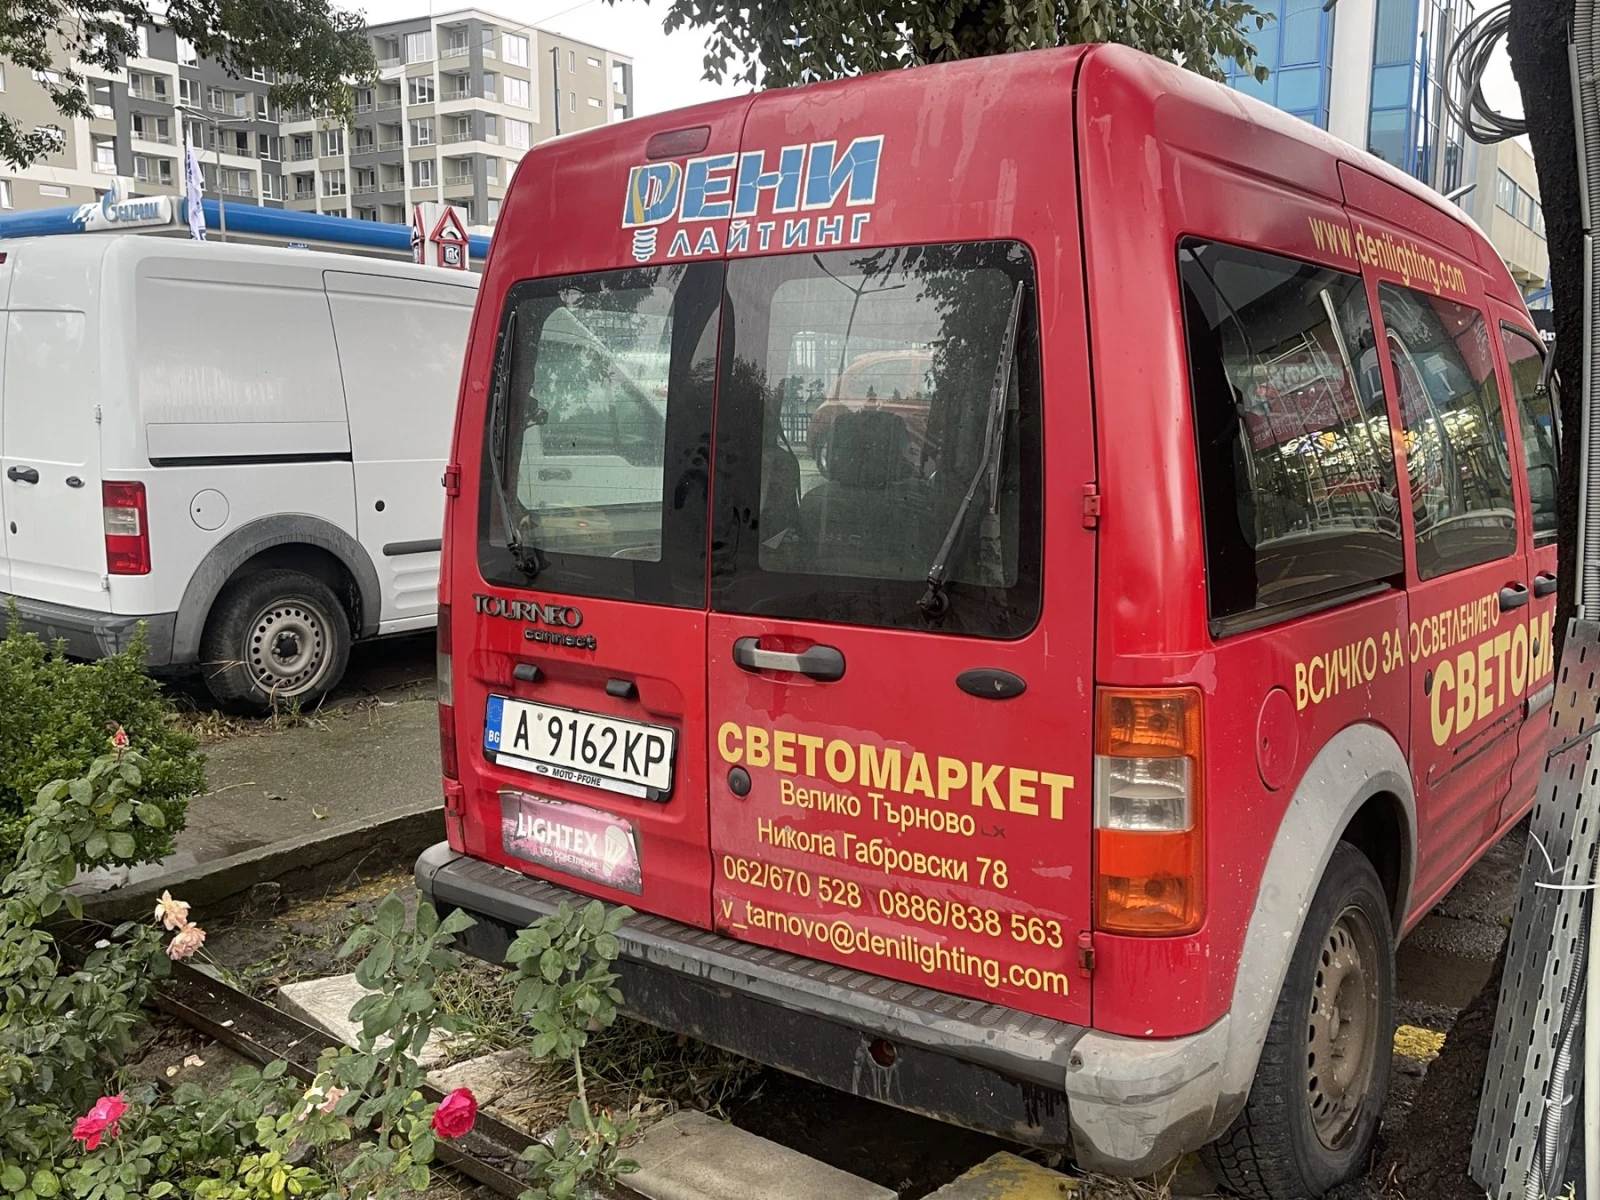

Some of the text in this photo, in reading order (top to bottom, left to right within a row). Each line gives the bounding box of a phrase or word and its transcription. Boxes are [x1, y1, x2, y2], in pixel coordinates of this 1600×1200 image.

[667, 212, 870, 257] ЛАЙТИНГ
[1308, 216, 1467, 295] www.denilighting.com
[472, 594, 583, 628] TOURNEO
[524, 627, 597, 649] connect
[1295, 591, 1500, 711] ВСИЧКО ЗА ОСВЕТЛЕНИЕТО
[1431, 606, 1557, 746] СВЕТОМ
[488, 730, 500, 743] BG
[513, 709, 529, 750] A
[717, 721, 1075, 820] СВЕТОМАРКЕТ
[516, 812, 598, 857] LIGHTEX
[780, 778, 976, 837] Велико Търново
[758, 817, 1009, 889] Никола Габровски 78
[723, 855, 1063, 948] 062/670 528 0886/838 563
[721, 899, 1069, 996] v_tarnovo@denilighting.com
